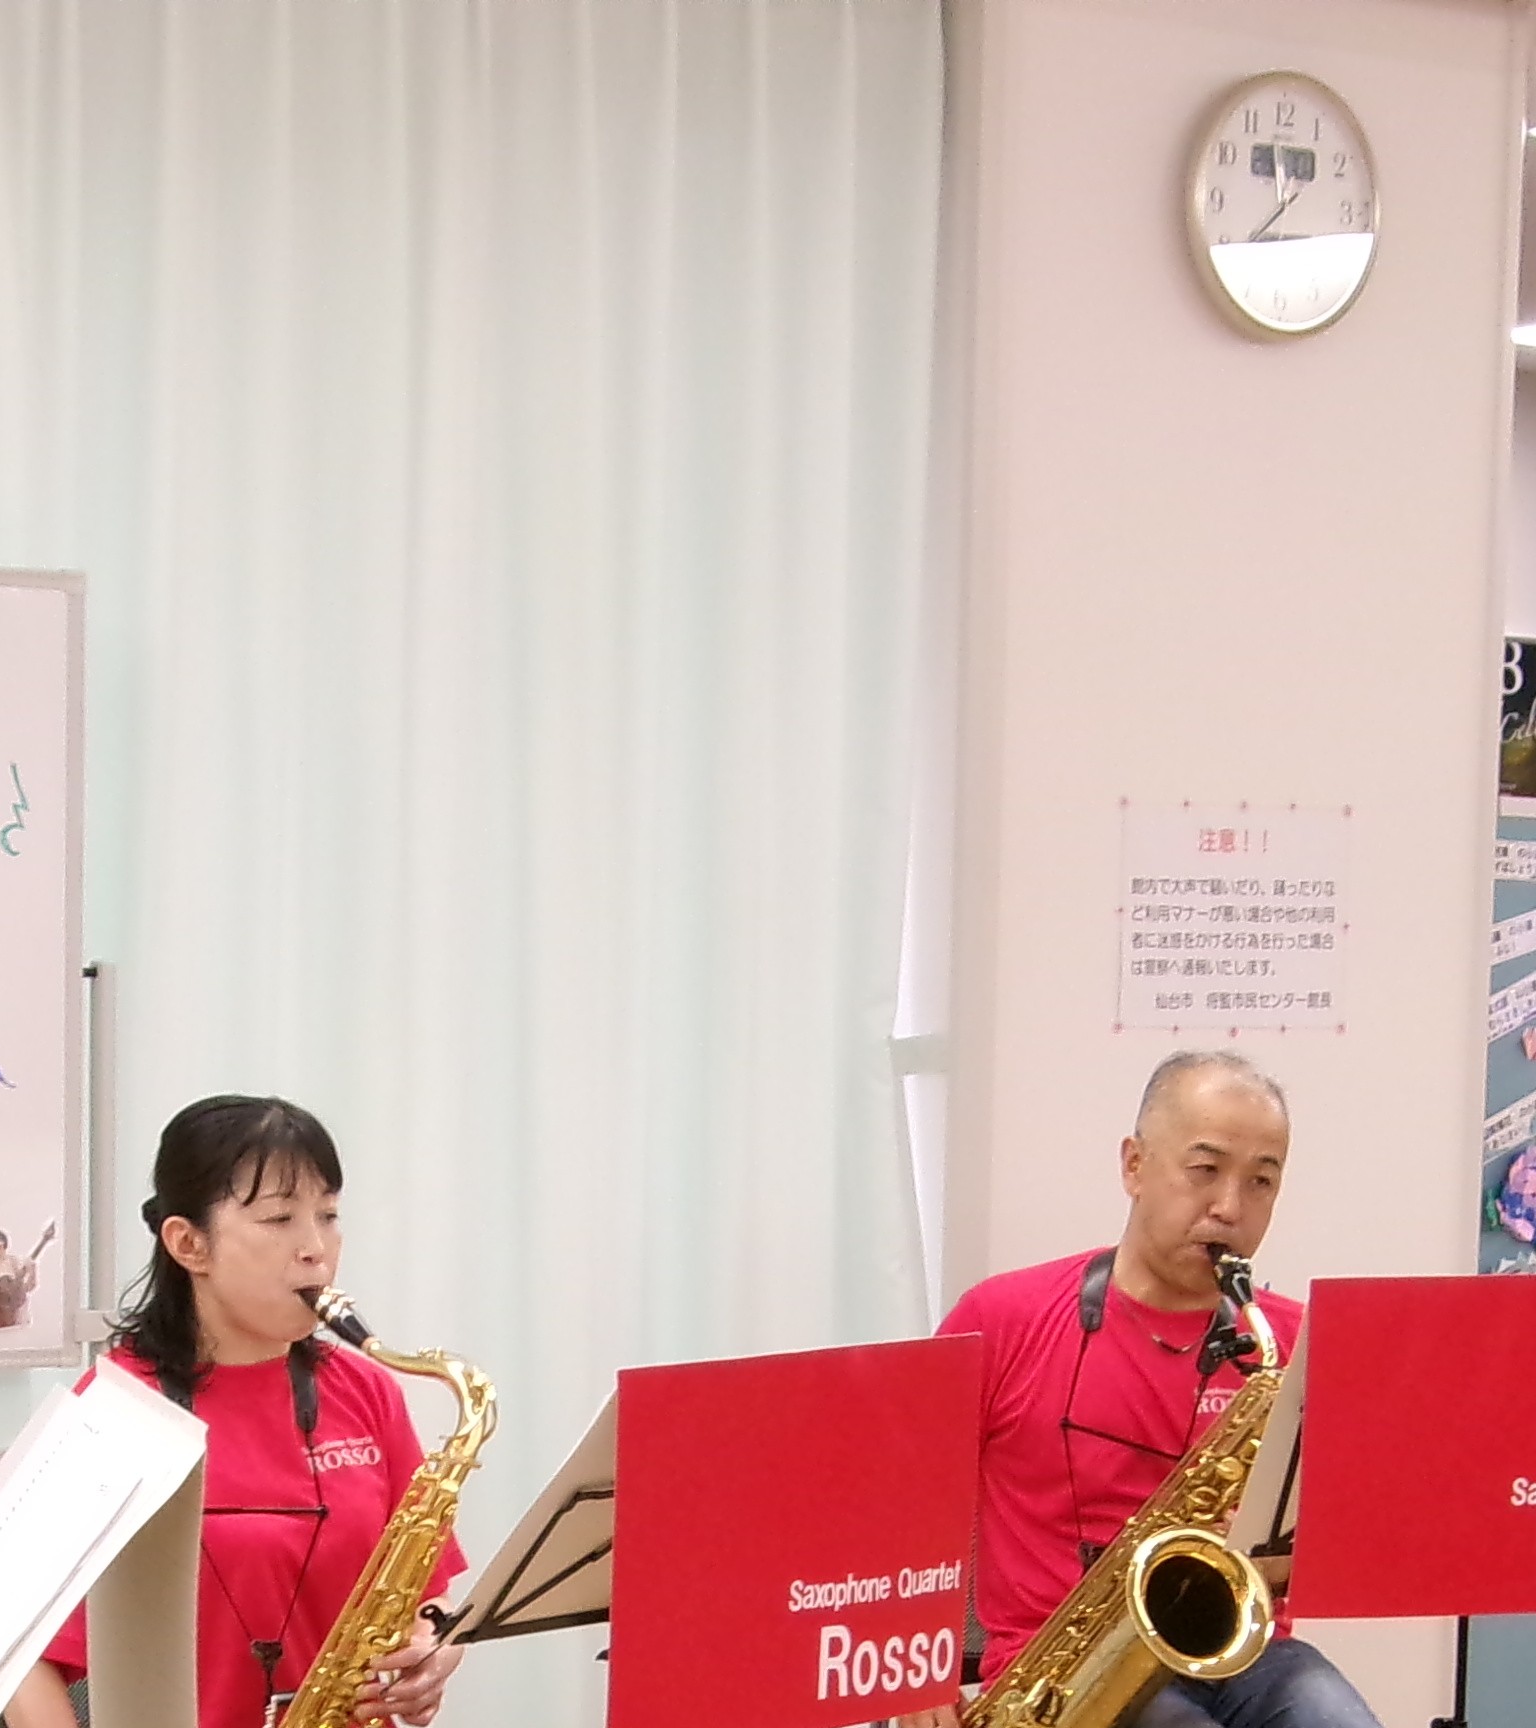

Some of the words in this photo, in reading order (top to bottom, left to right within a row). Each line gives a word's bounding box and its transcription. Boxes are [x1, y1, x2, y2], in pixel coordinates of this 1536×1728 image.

[1243, 109, 1260, 134] 11
[1275, 101, 1296, 127] 12
[1217, 141, 1238, 166] 10
[1333, 152, 1347, 178] 2
[1210, 186, 1225, 214] 9
[1339, 200, 1353, 226] 3
[307, 1445, 381, 1475] ROSSO
[788, 1573, 891, 1612] Saxophone
[898, 1559, 961, 1599] Quartet
